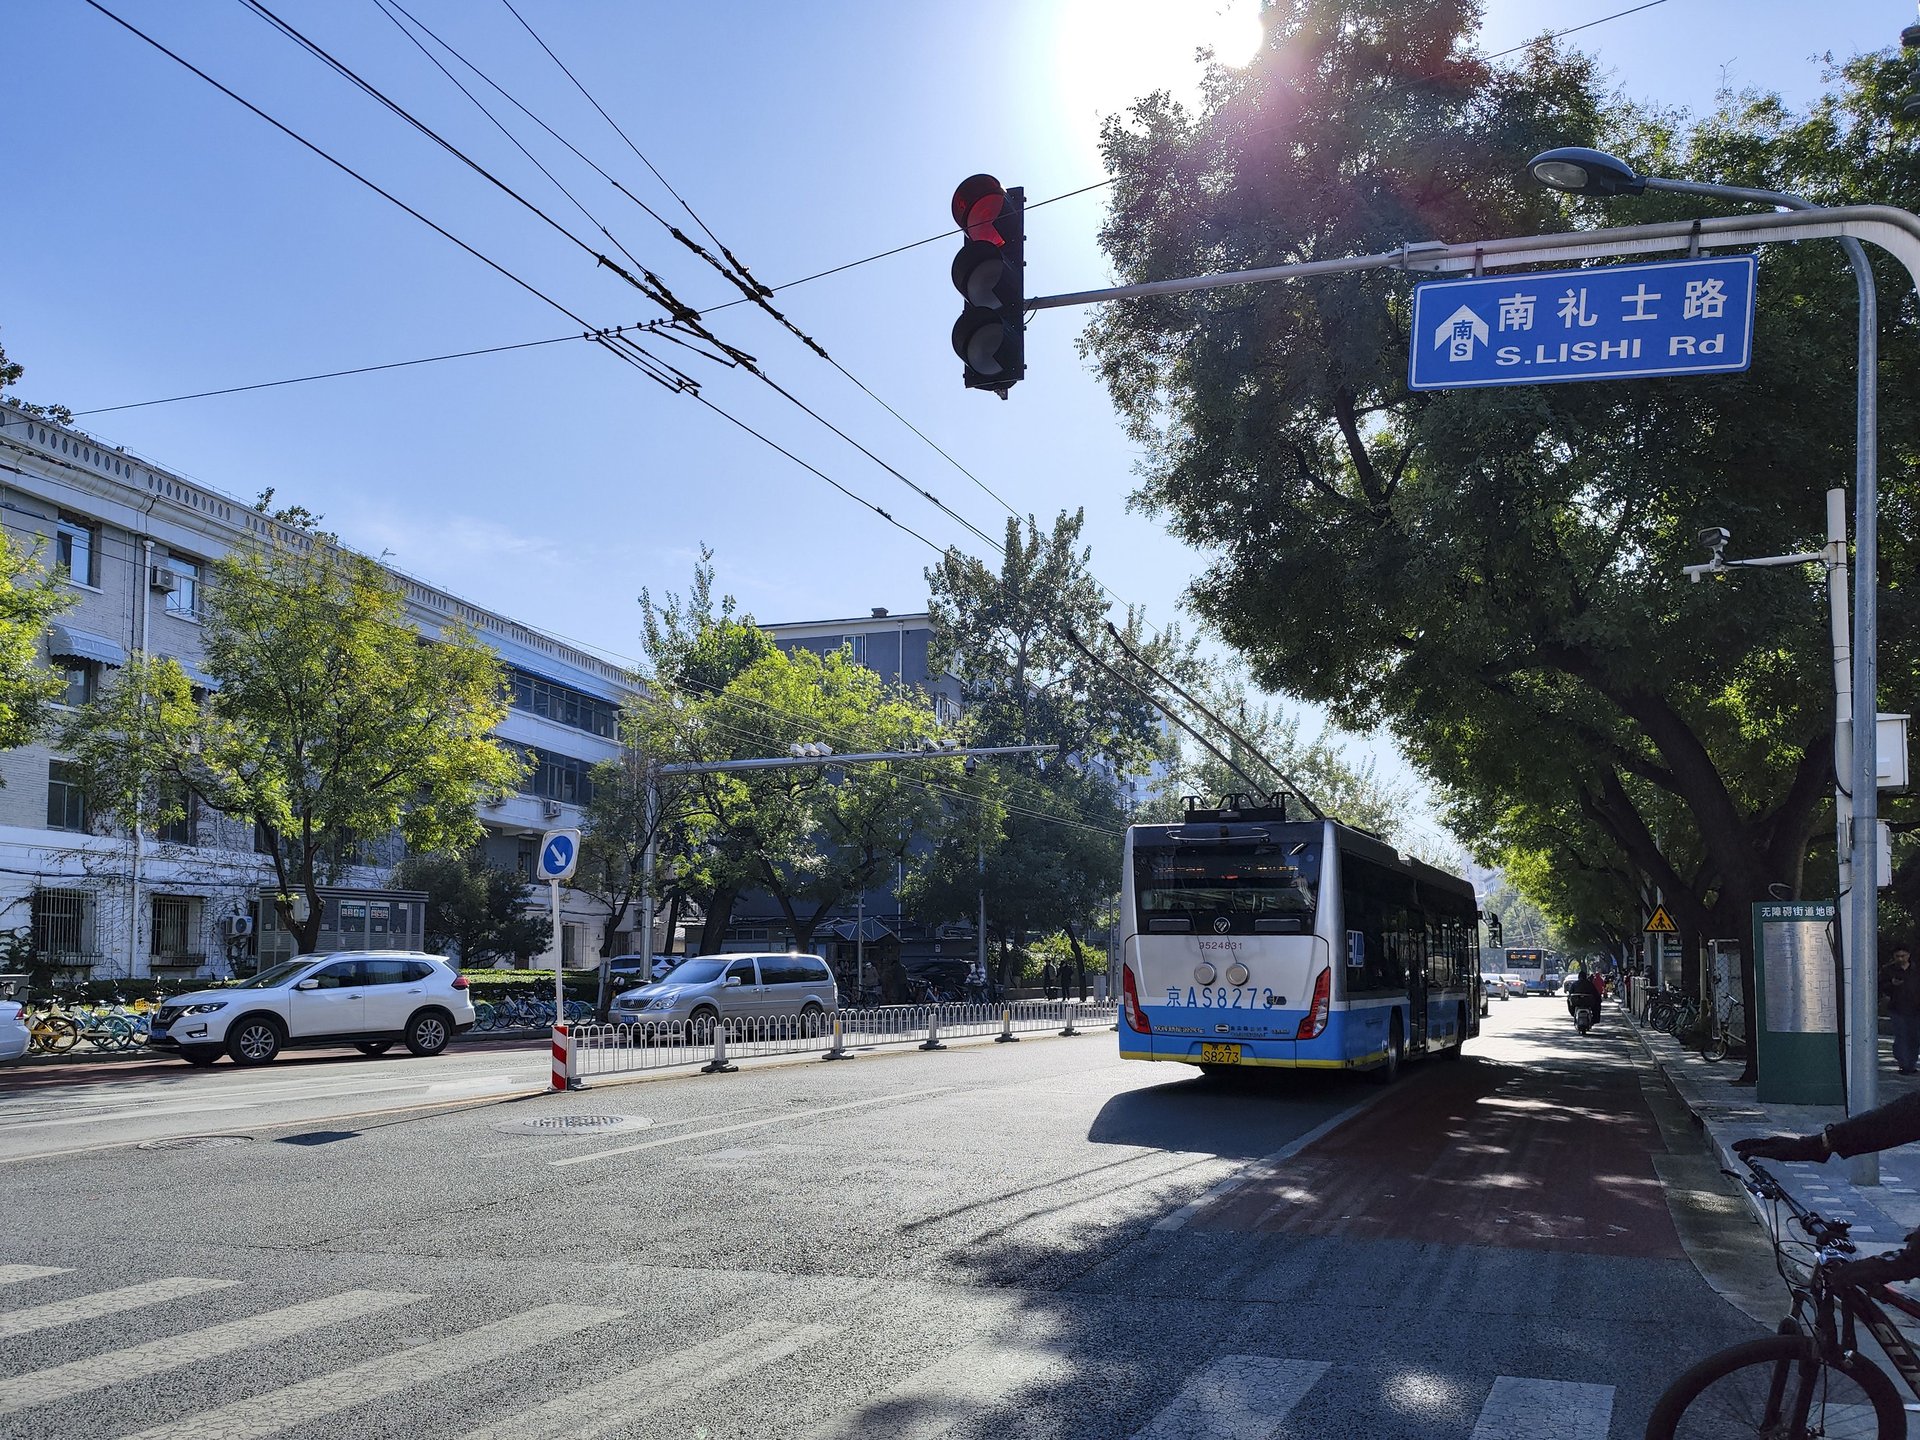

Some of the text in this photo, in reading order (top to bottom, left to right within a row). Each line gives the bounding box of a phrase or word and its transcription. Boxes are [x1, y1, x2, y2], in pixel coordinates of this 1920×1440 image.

[1498, 278, 1728, 332] 南礼士路
[1453, 320, 1473, 340] 南
[1454, 343, 1468, 356] S
[1495, 333, 1725, 366] S.LISHI Rd
[1761, 906, 1835, 917] 无障碍街道地图
[1199, 942, 1242, 950] 9524831
[1166, 986, 1273, 1010] 京AS8273
[1203, 1051, 1239, 1063] S8273
